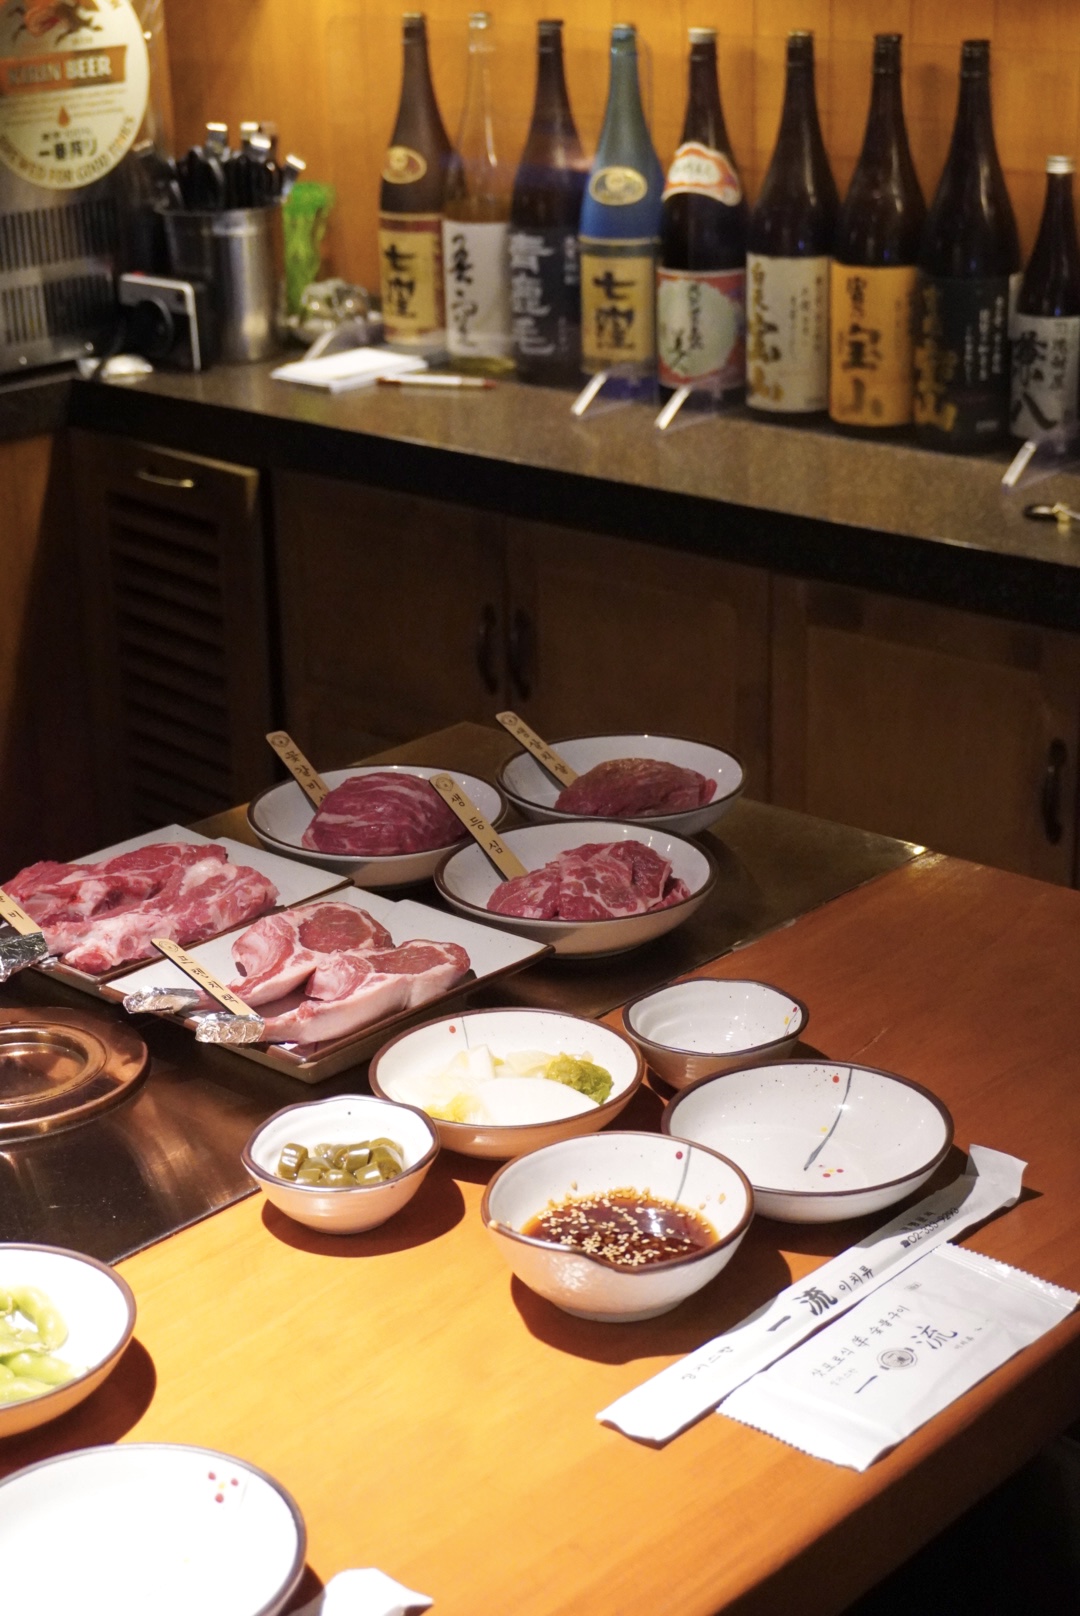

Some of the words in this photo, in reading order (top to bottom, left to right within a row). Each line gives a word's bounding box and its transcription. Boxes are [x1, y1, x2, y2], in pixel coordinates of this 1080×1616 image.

[65, 54, 112, 80] BEER
[838, 1264, 876, 1293] 이치류
[869, 1304, 912, 1336] 숯불구이
